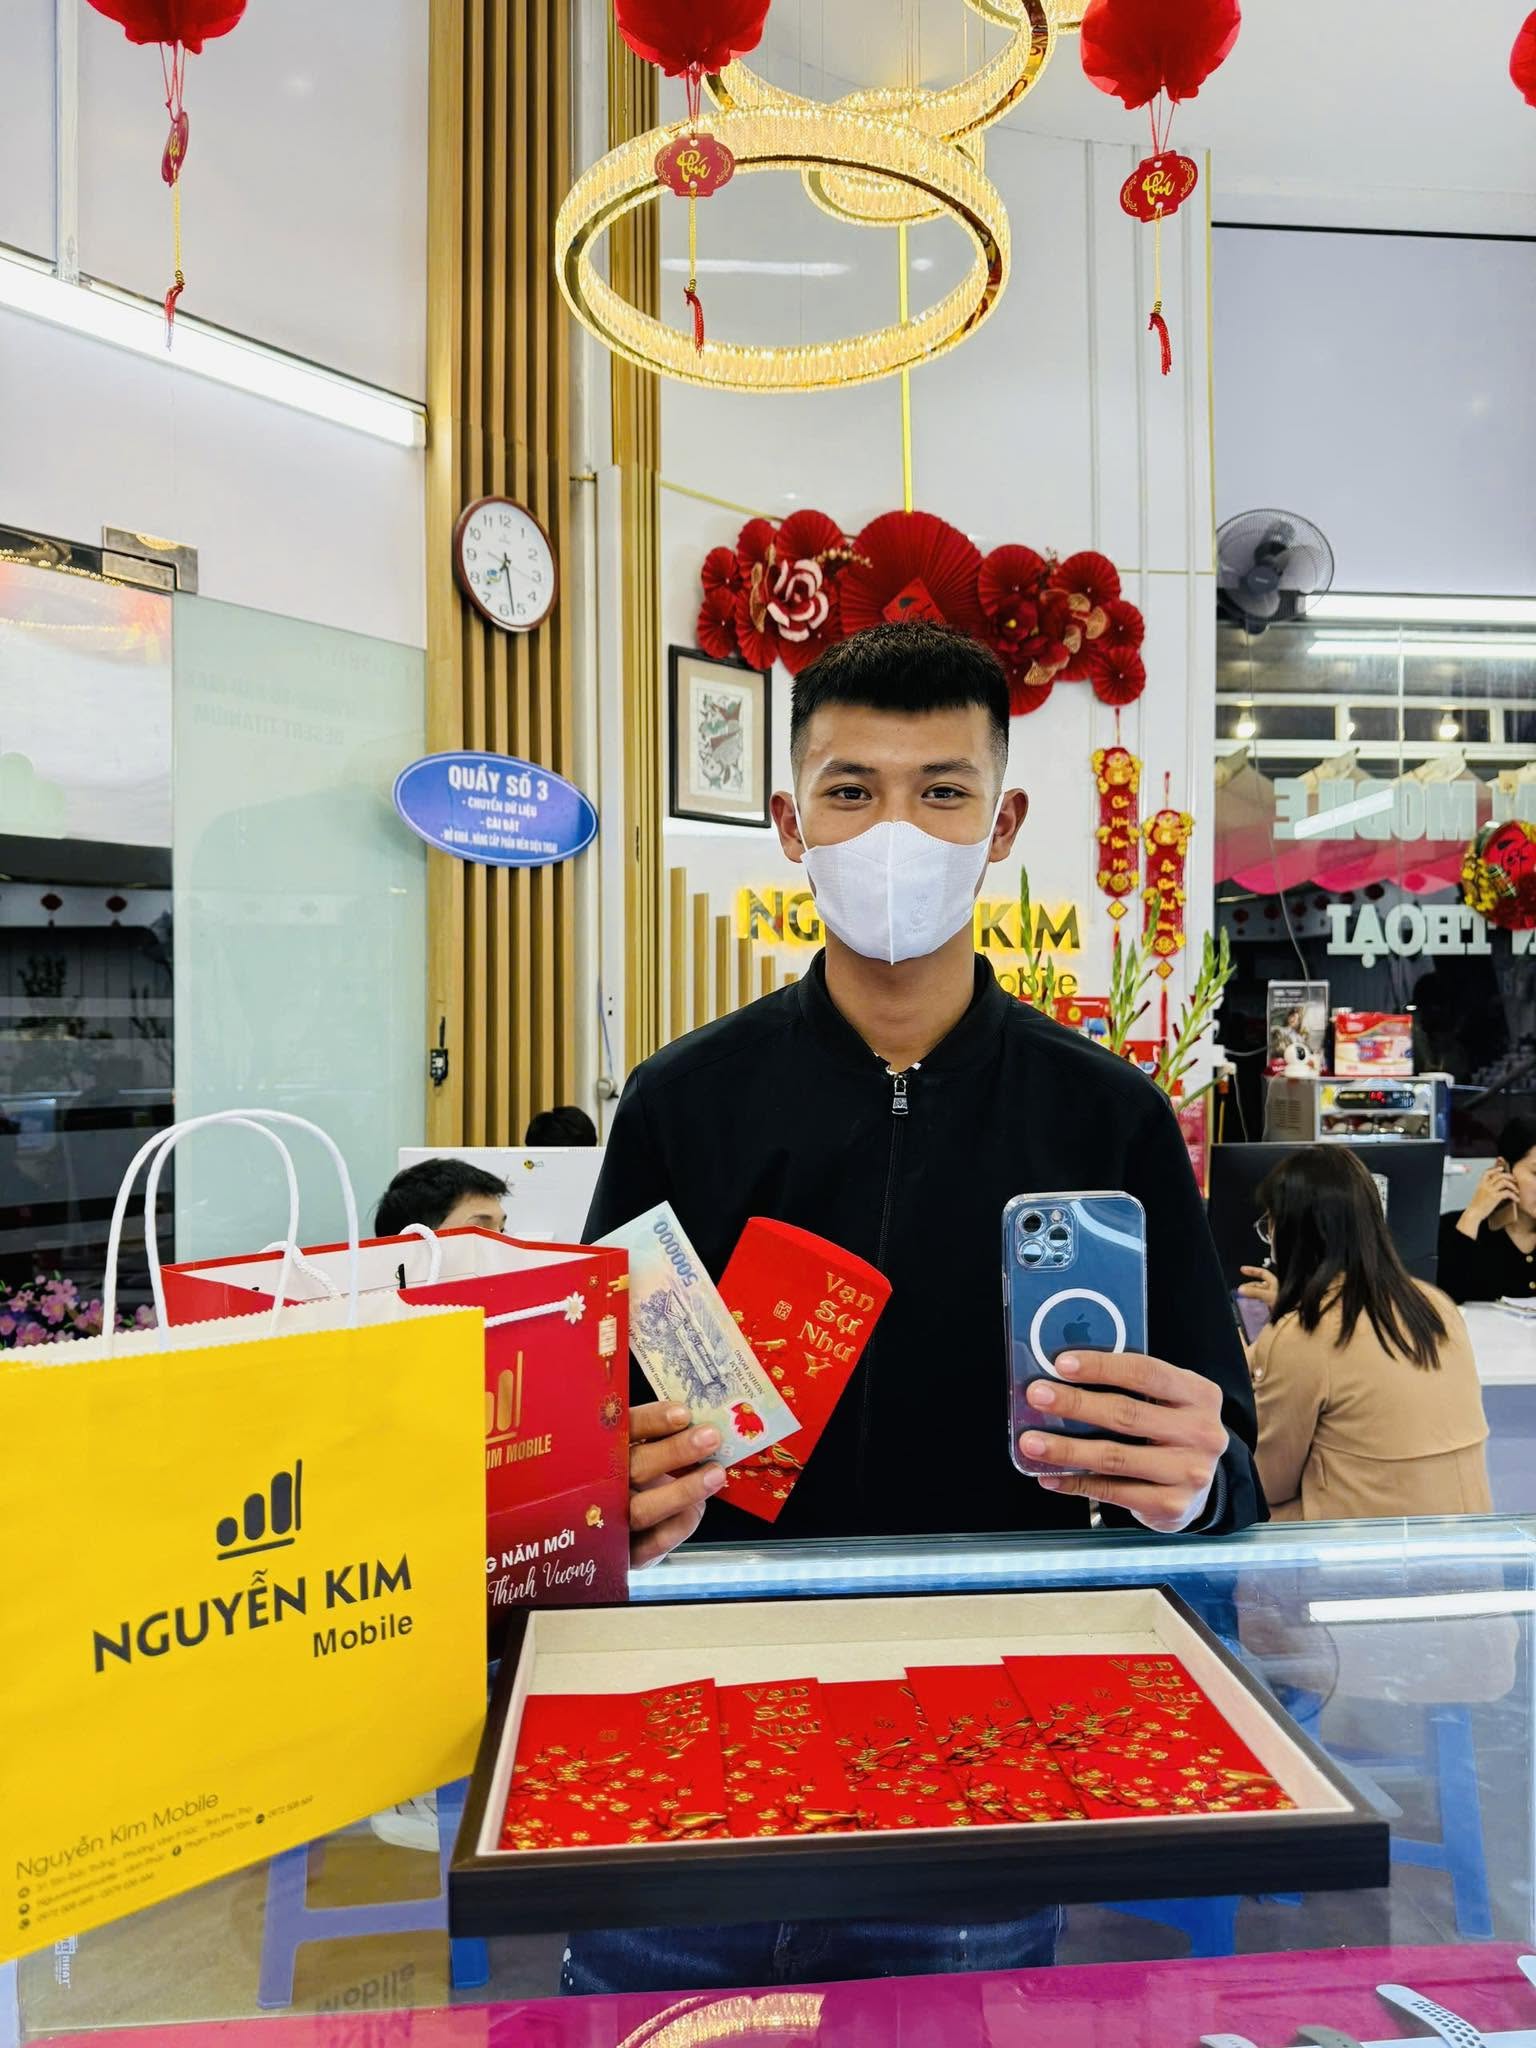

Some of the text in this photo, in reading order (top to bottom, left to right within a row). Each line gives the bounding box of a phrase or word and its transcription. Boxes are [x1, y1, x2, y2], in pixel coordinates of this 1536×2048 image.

[483, 514, 493, 528] 11
[499, 514, 512, 528] 12
[466, 548, 477, 561] 9
[528, 548, 538, 561] 2
[528, 591, 537, 601] 4
[506, 770, 533, 798] SỐ
[537, 780, 549, 801] 3
[653, 1220, 698, 1288] 500000
[826, 1271, 875, 1312] Vạn
[815, 1300, 863, 1336] Sự
[797, 1320, 856, 1363] Như
[804, 1352, 832, 1378] Ý
[506, 1433, 552, 1464] MOBILE
[501, 1542, 539, 1568] NĂM
[544, 1529, 575, 1554] MỚI
[487, 1559, 596, 1607] Thịnh Vượng
[93, 1552, 412, 1673] NGUYỄN KIM
[313, 1613, 413, 1658] Mobile
[110, 1821, 147, 1846] Kim
[152, 1793, 219, 1829] Mobile
